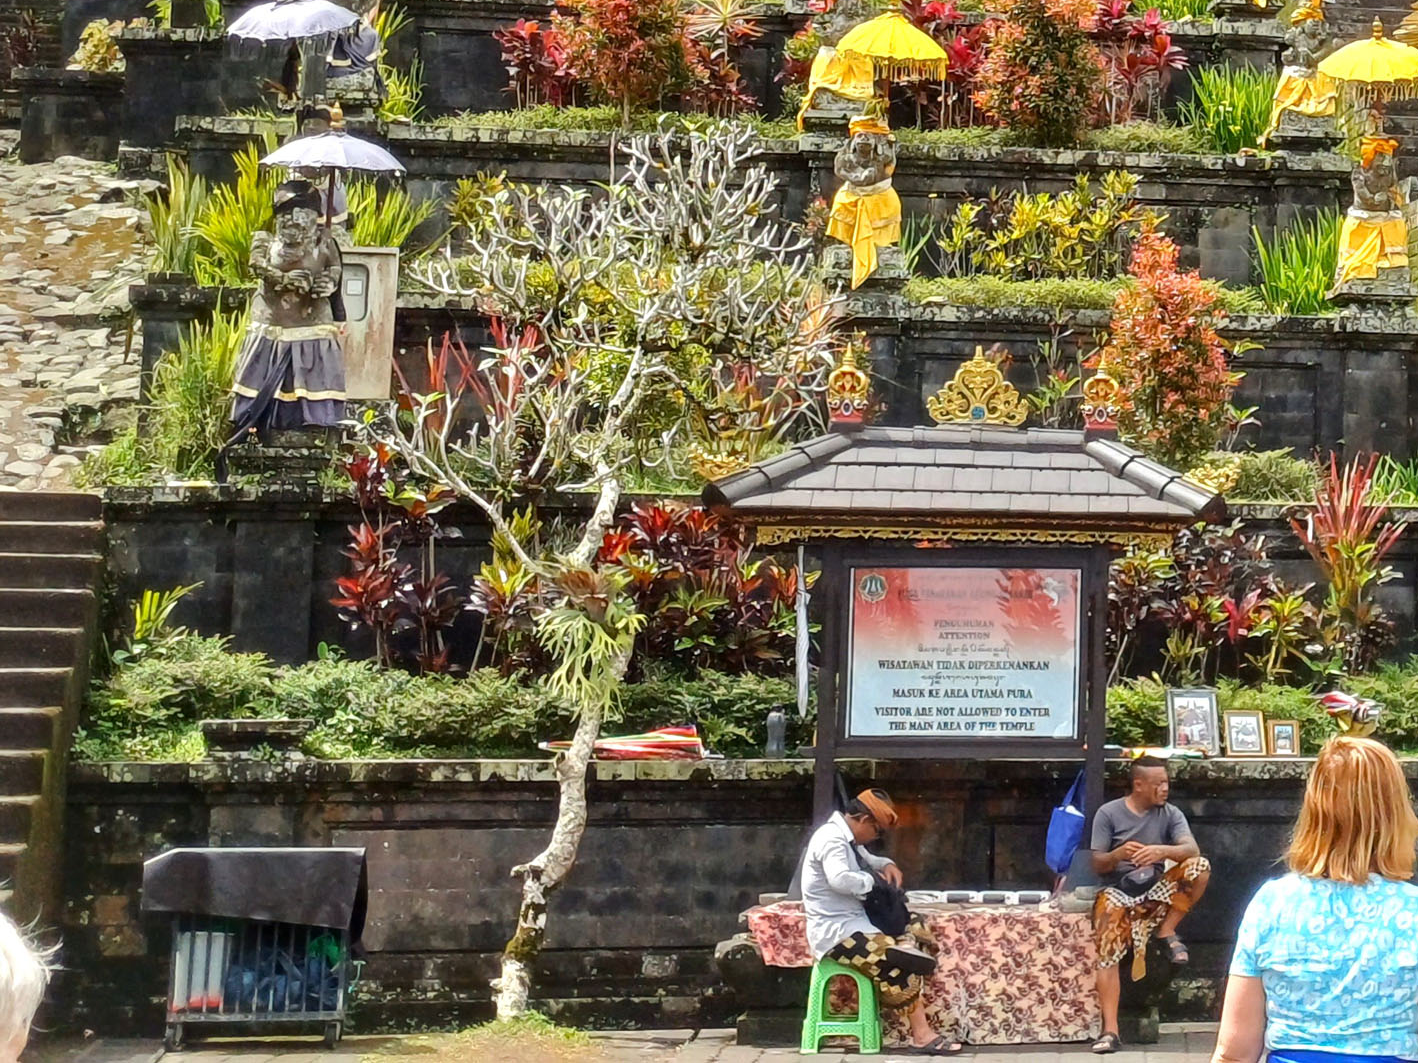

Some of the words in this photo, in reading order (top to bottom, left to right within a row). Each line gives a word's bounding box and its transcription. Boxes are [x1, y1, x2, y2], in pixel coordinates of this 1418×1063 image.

[938, 631, 990, 640] ATTENTION
[878, 659, 934, 670] WISATAWAN
[936, 660, 966, 670] TIDAK
[968, 660, 1050, 670] DIPERKENANKAN
[892, 688, 926, 698] MASUK
[928, 688, 941, 698] KE
[943, 688, 969, 698] AREA
[971, 688, 1004, 699] UTAMA
[1007, 688, 1033, 699] PURA
[874, 706, 912, 717] VISITOR
[914, 706, 933, 717] ARE
[936, 706, 955, 717] NOT
[957, 706, 1002, 717] ALLOWED
[1005, 706, 1017, 717] TO
[1019, 707, 1050, 718] ENTER
[888, 720, 907, 731] THE
[909, 721, 934, 731] MAIN
[936, 721, 962, 731] AREA
[964, 721, 977, 731] OF
[979, 721, 997, 732] THE
[999, 721, 1035, 732] TEMPLE
